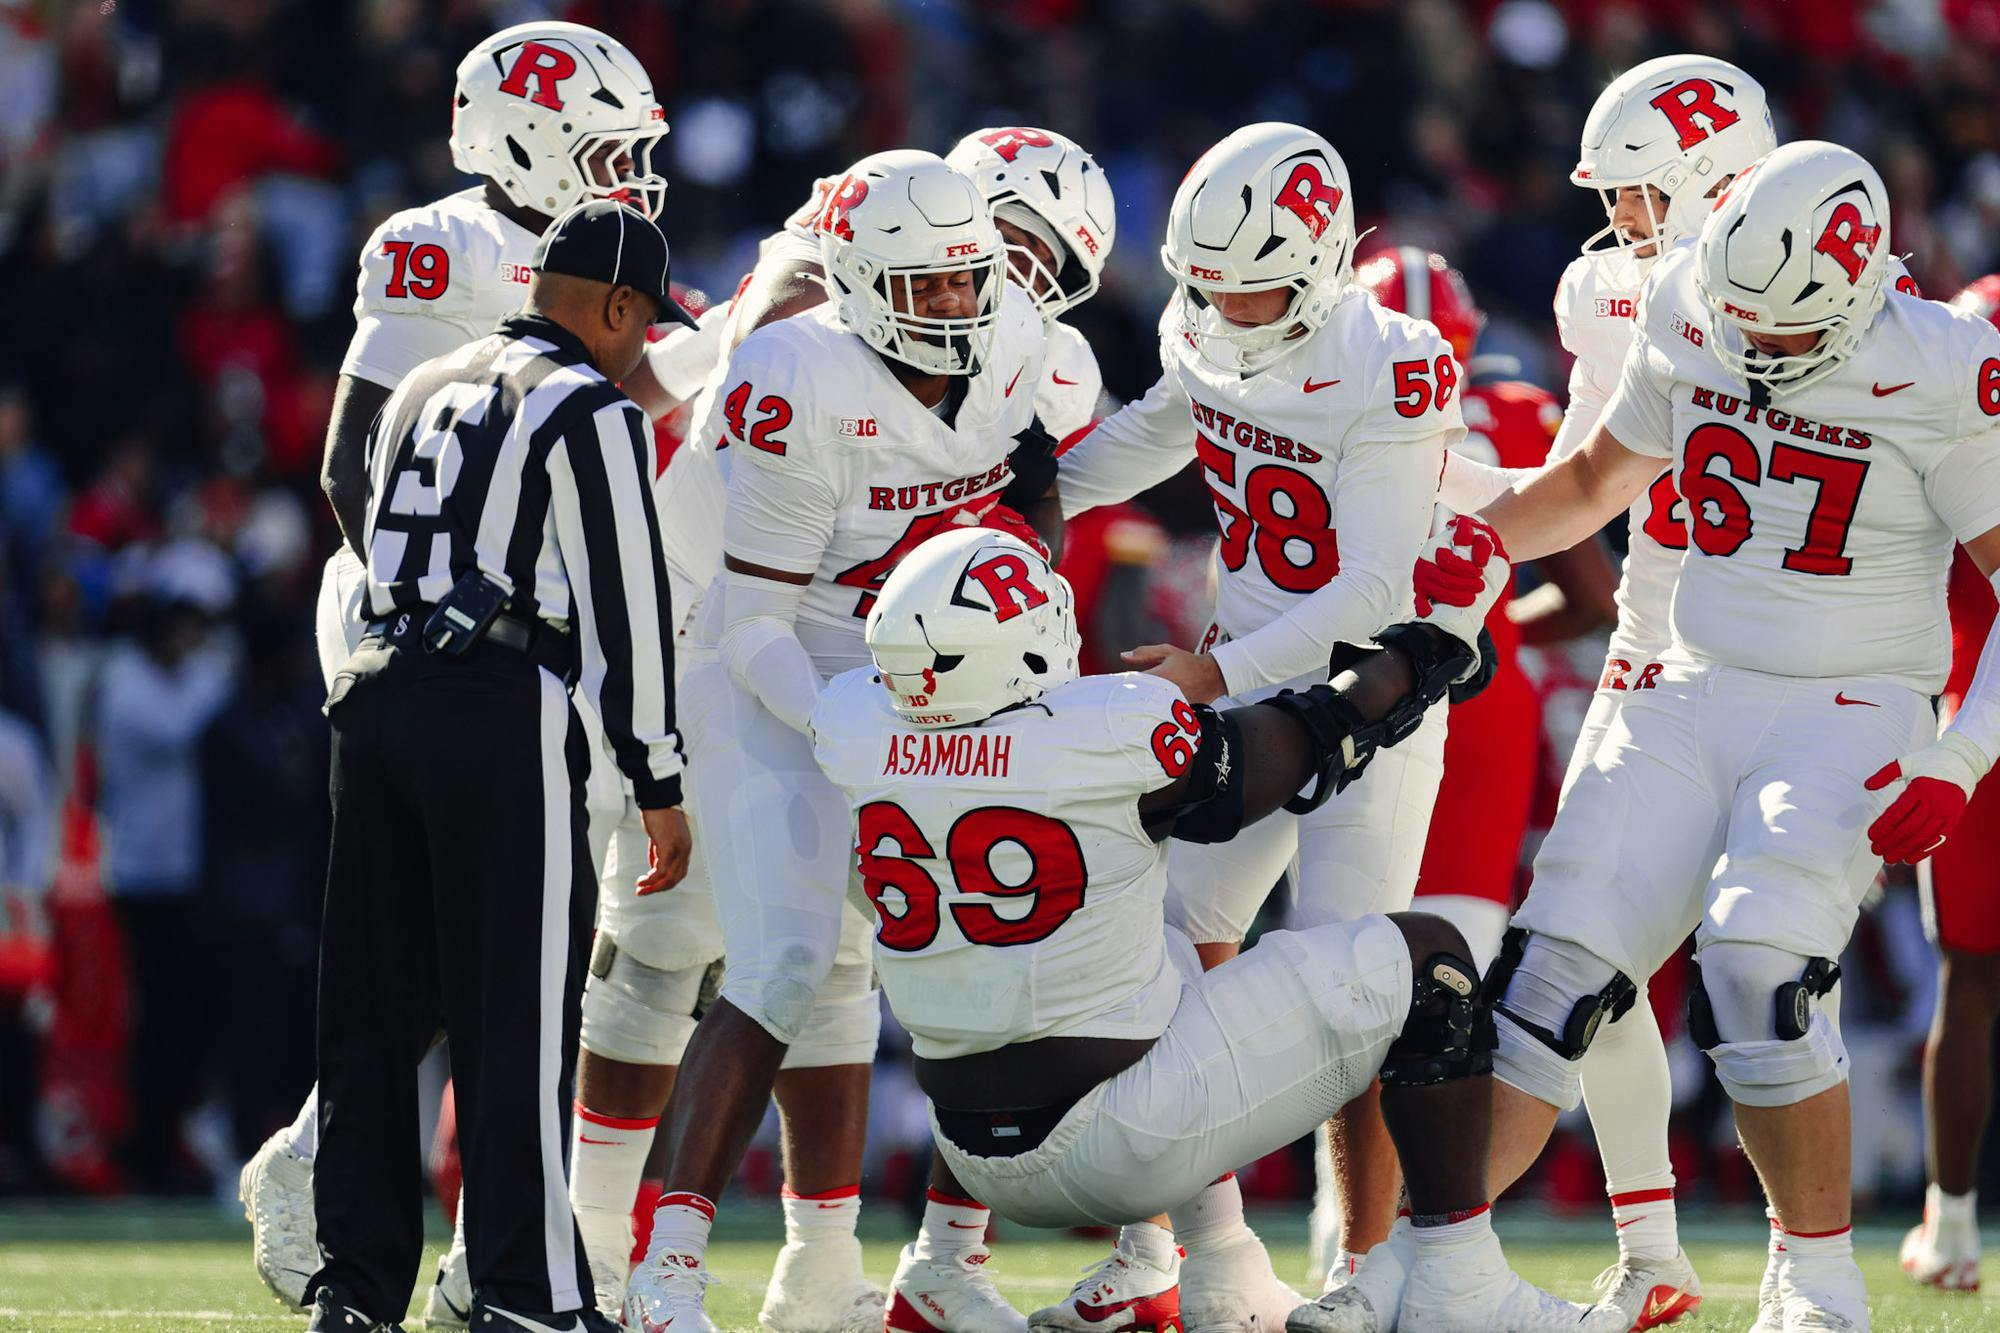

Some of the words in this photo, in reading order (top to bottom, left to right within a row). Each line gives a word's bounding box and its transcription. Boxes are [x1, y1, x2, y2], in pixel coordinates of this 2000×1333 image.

[499, 40, 576, 112] R
[978, 127, 1054, 164] R
[1649, 78, 1740, 151] R
[1275, 163, 1344, 243] R
[382, 241, 449, 300] 79
[1814, 202, 1882, 285] R
[715, 381, 792, 456] 42
[1393, 354, 1456, 418] 58
[1688, 386, 1872, 449] RUTGERS
[1195, 428, 1340, 594] 58
[1680, 422, 1871, 576] 67
[393, 613, 411, 637] S
[968, 554, 1050, 624] R
[1633, 663, 1664, 691] R
[882, 734, 1011, 778] ASAMOAH
[1151, 699, 1204, 778] 69
[855, 800, 1088, 952] 69
